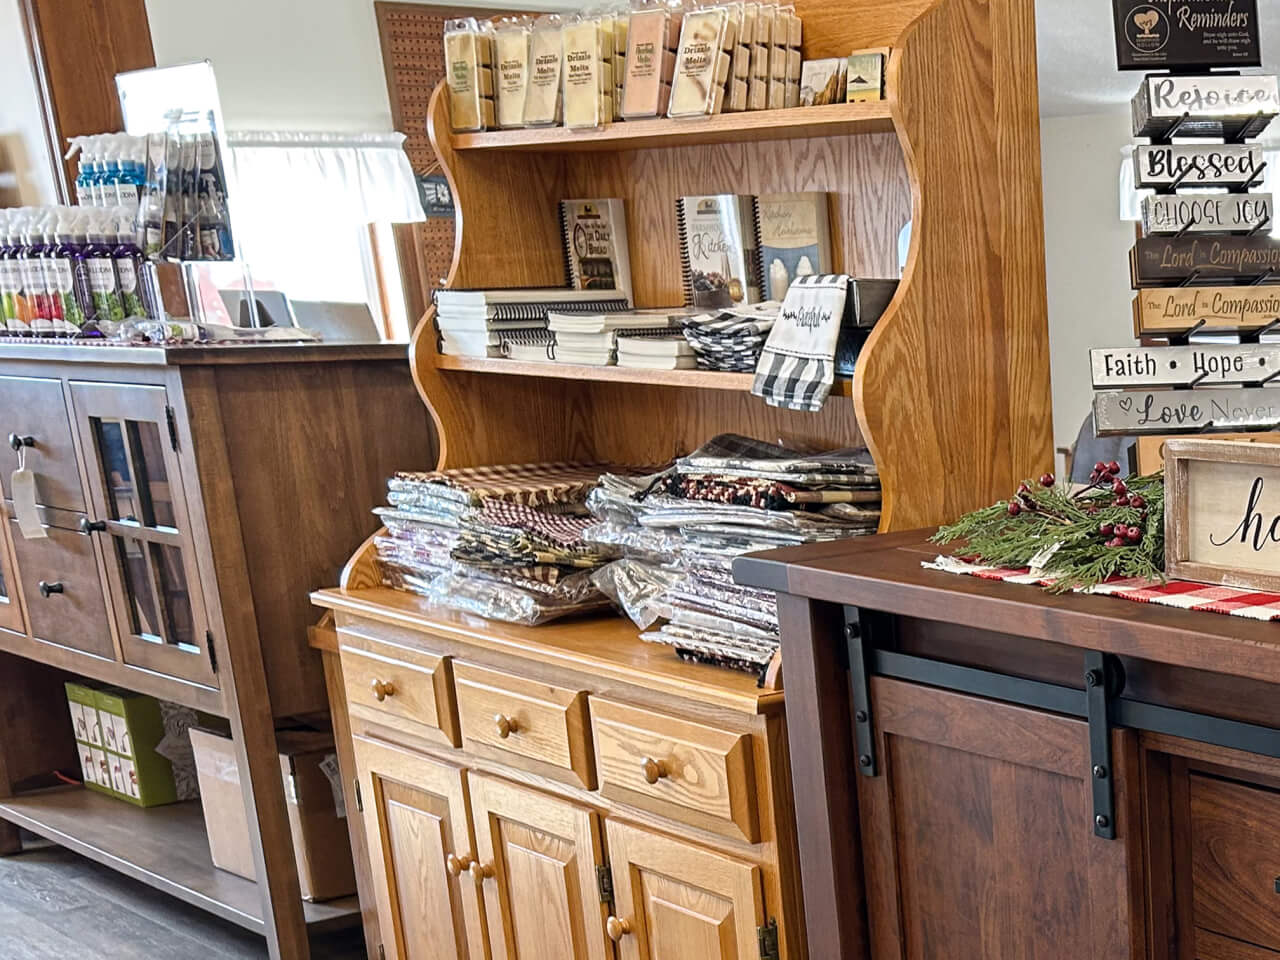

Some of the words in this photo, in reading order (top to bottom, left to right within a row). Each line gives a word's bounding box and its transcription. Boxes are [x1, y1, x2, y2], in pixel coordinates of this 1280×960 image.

[1177, 2, 1249, 31] Reminders
[1154, 79, 1273, 110] Rejoice
[1147, 150, 1256, 180] Blessed
[1154, 199, 1223, 226] CHOOSE
[1232, 200, 1268, 225] JOY
[1160, 240, 1196, 268] Lord
[1162, 292, 1198, 318] Lord
[1104, 353, 1157, 377] Faith
[1193, 352, 1244, 377] Hope
[1137, 394, 1204, 425] Love
[1211, 398, 1273, 420] Never
